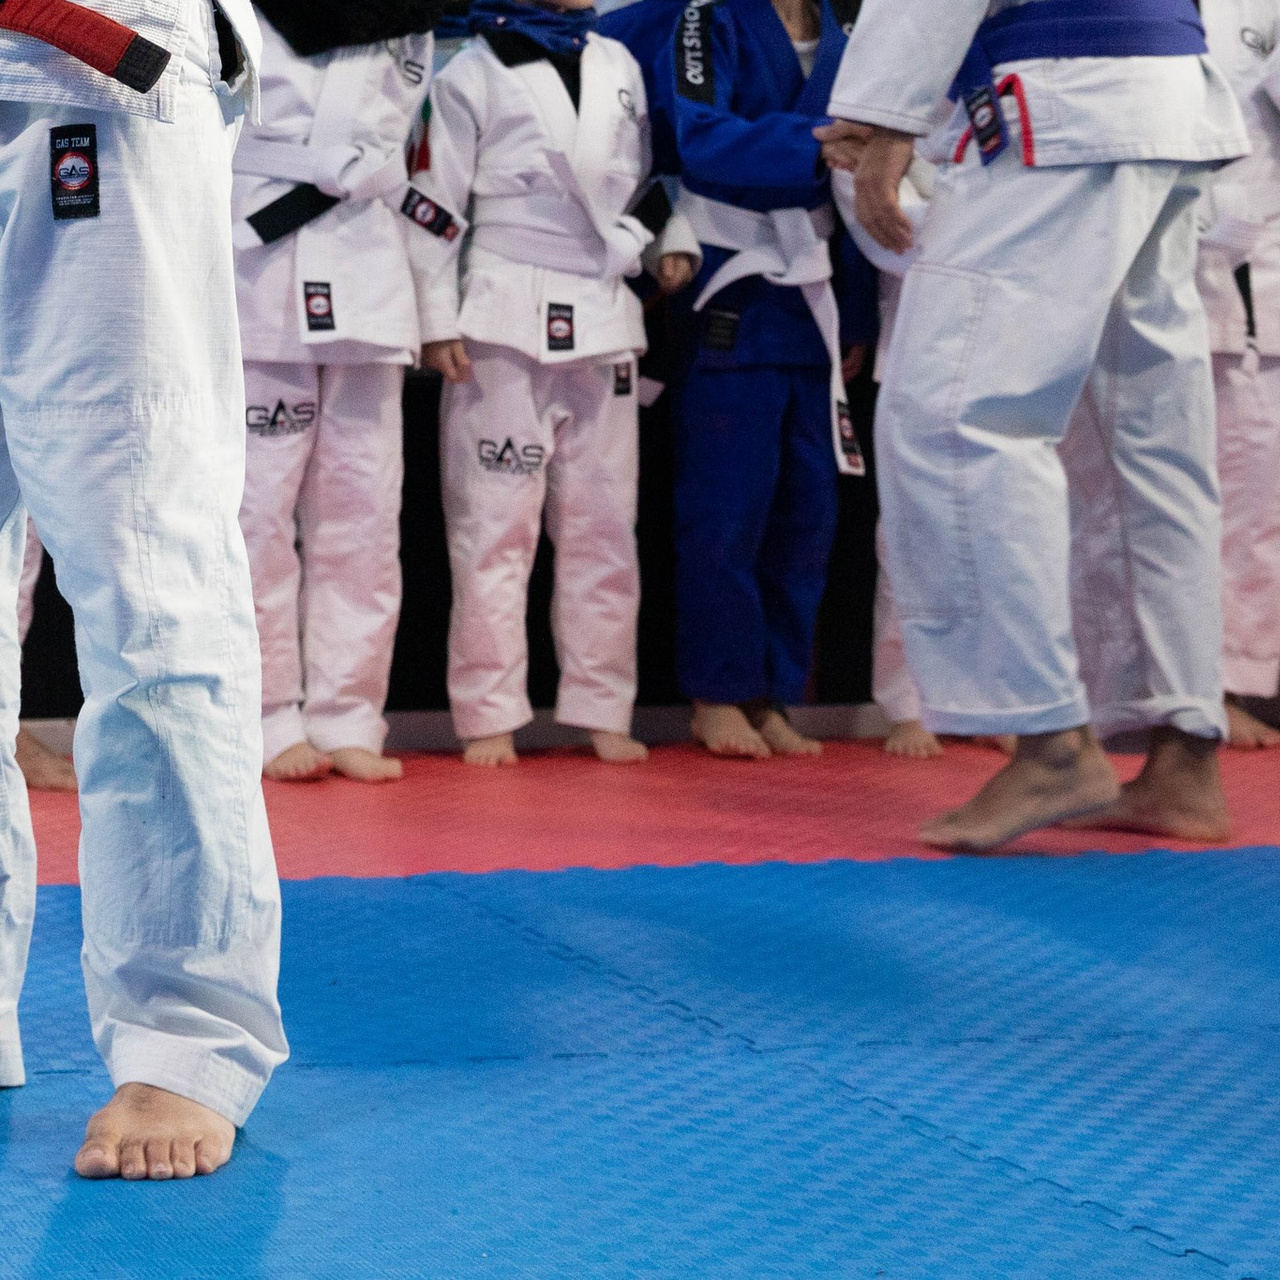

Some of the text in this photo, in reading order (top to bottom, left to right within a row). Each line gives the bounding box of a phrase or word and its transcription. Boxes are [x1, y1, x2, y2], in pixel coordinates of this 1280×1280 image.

[56, 137, 90, 149] GAS TEAM
[59, 164, 89, 178] GAS
[246, 399, 316, 428] GAS
[478, 437, 544, 467] GAS
